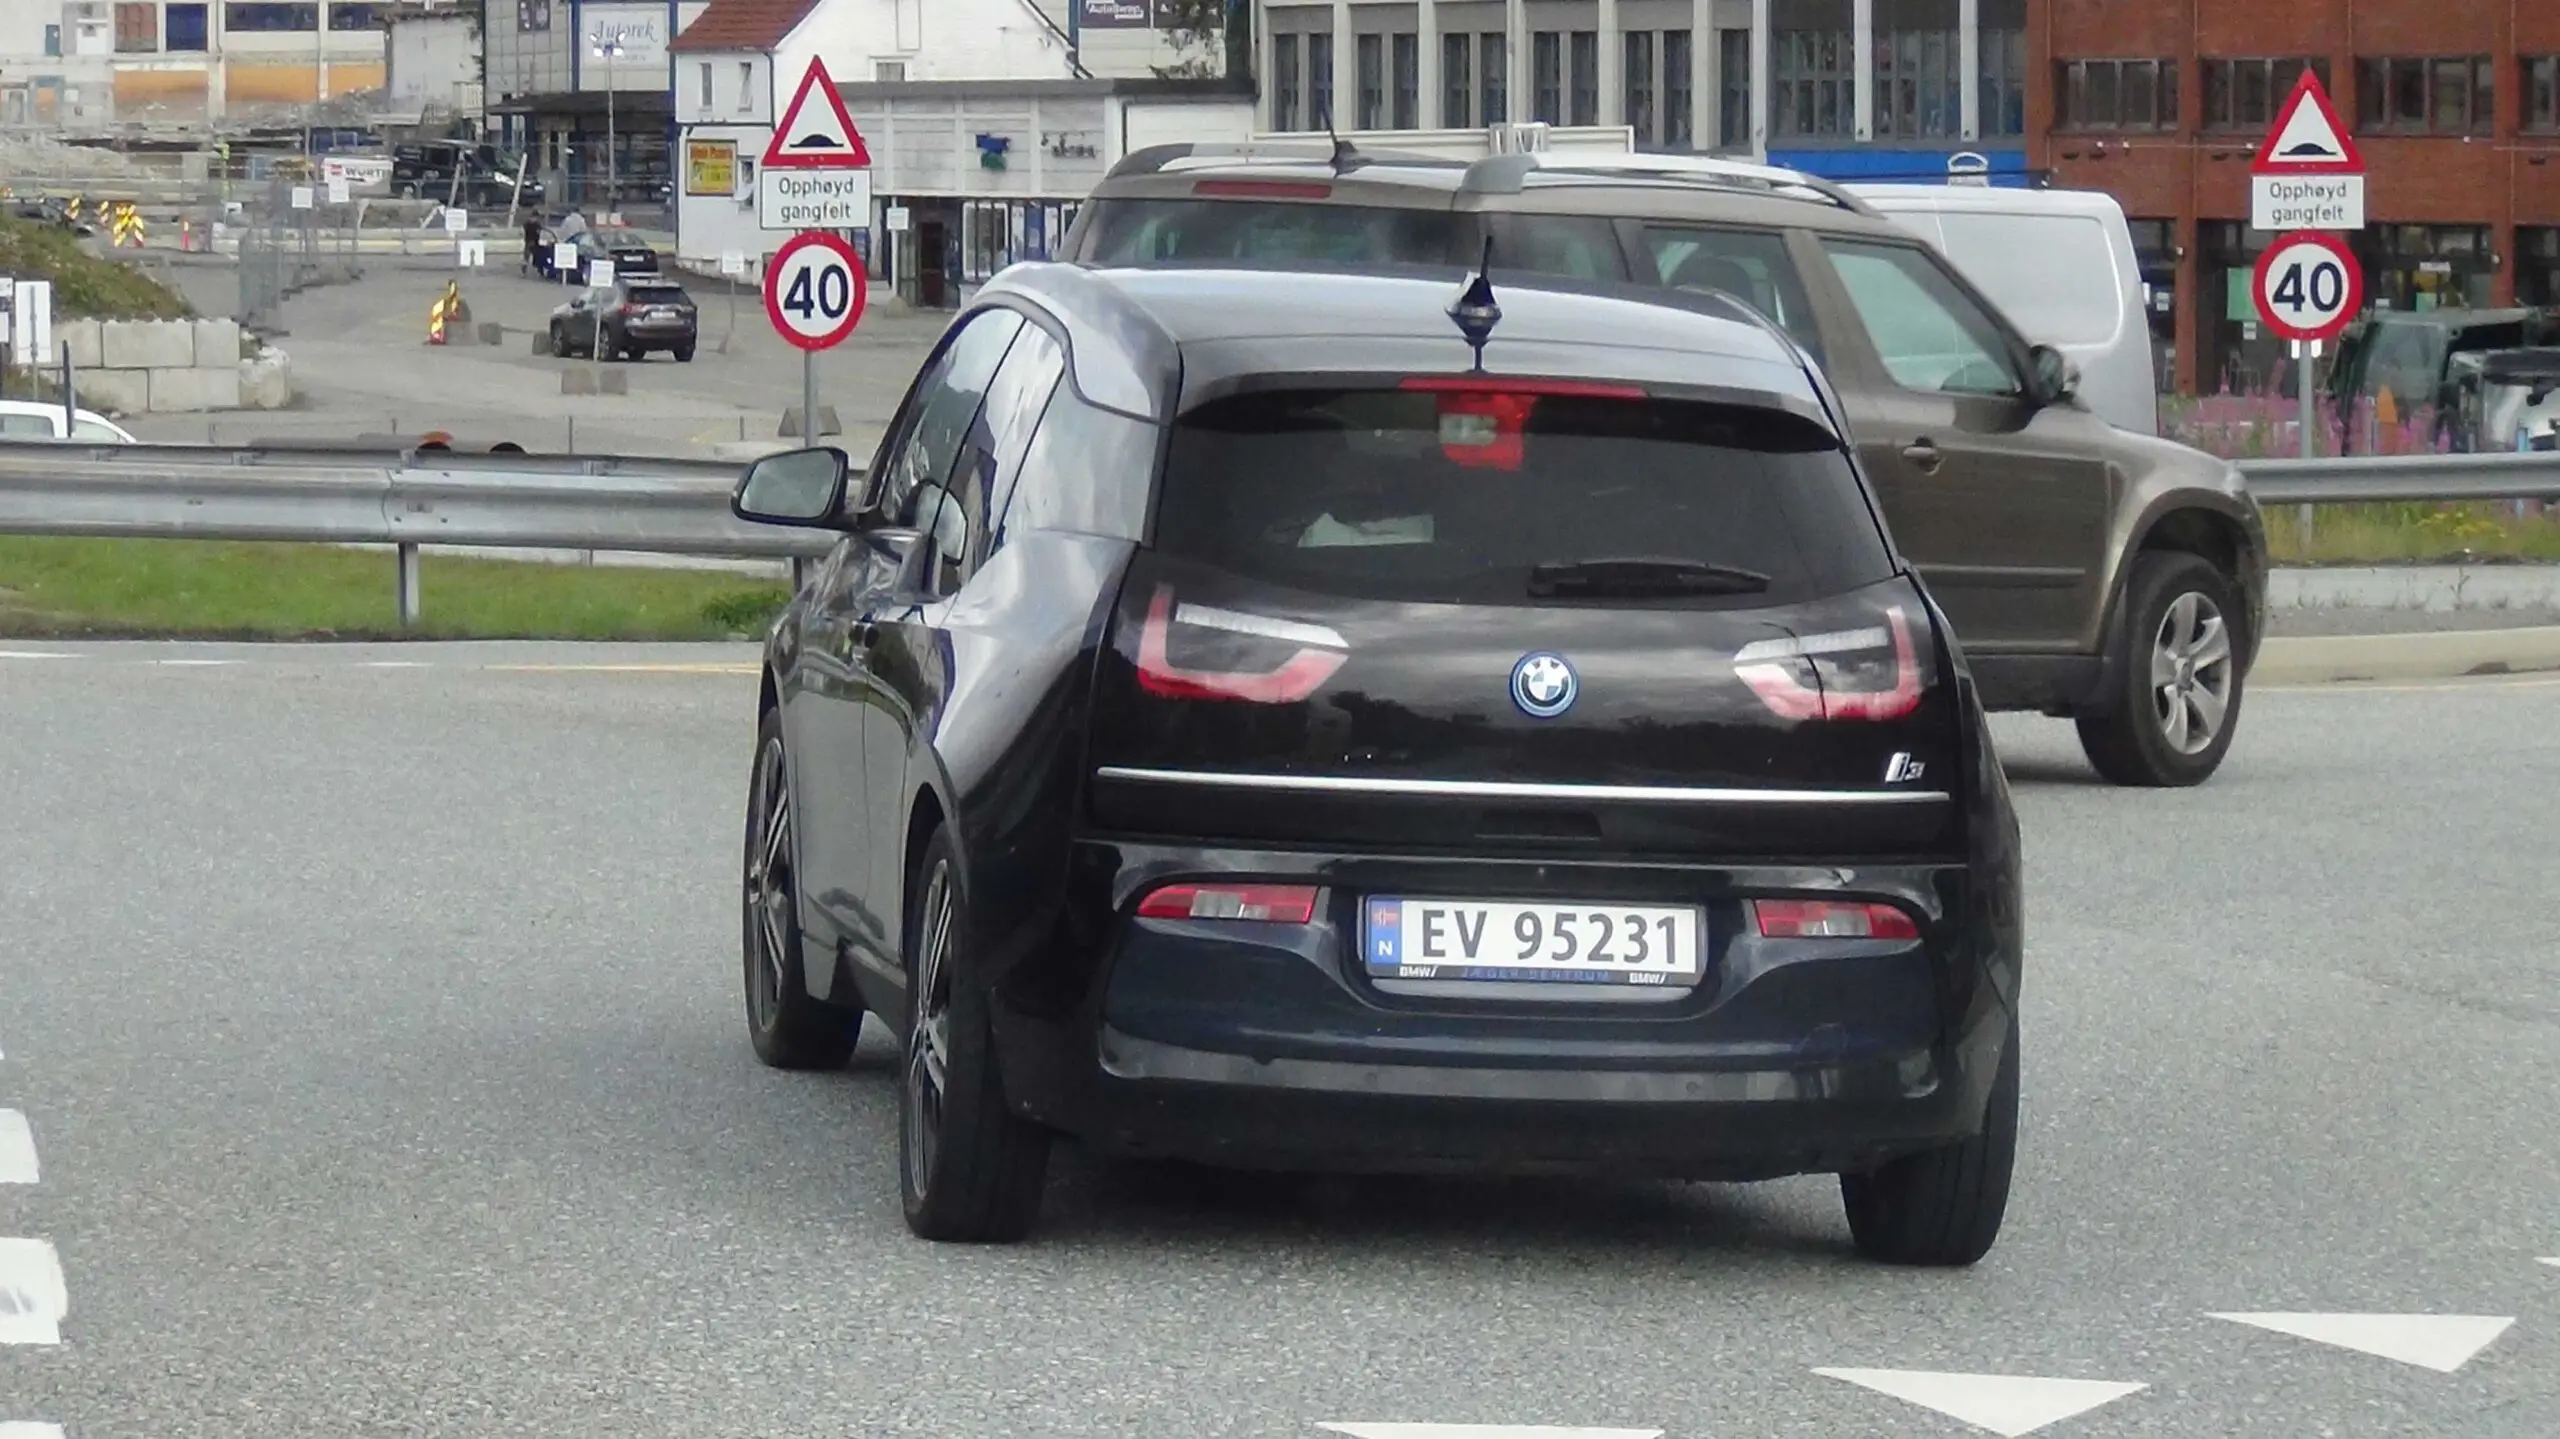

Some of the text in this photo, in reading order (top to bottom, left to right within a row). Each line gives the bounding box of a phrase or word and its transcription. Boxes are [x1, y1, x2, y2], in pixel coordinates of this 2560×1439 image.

[779, 177, 854, 199] Opphøyd
[2269, 182, 2347, 202] Opphøyd
[780, 200, 851, 223] gangfelt
[2271, 204, 2344, 226] gangfelt
[783, 263, 849, 320] 40
[2272, 261, 2344, 313] 40
[1377, 939, 1394, 957] N
[1421, 909, 1677, 965] EV 95231
